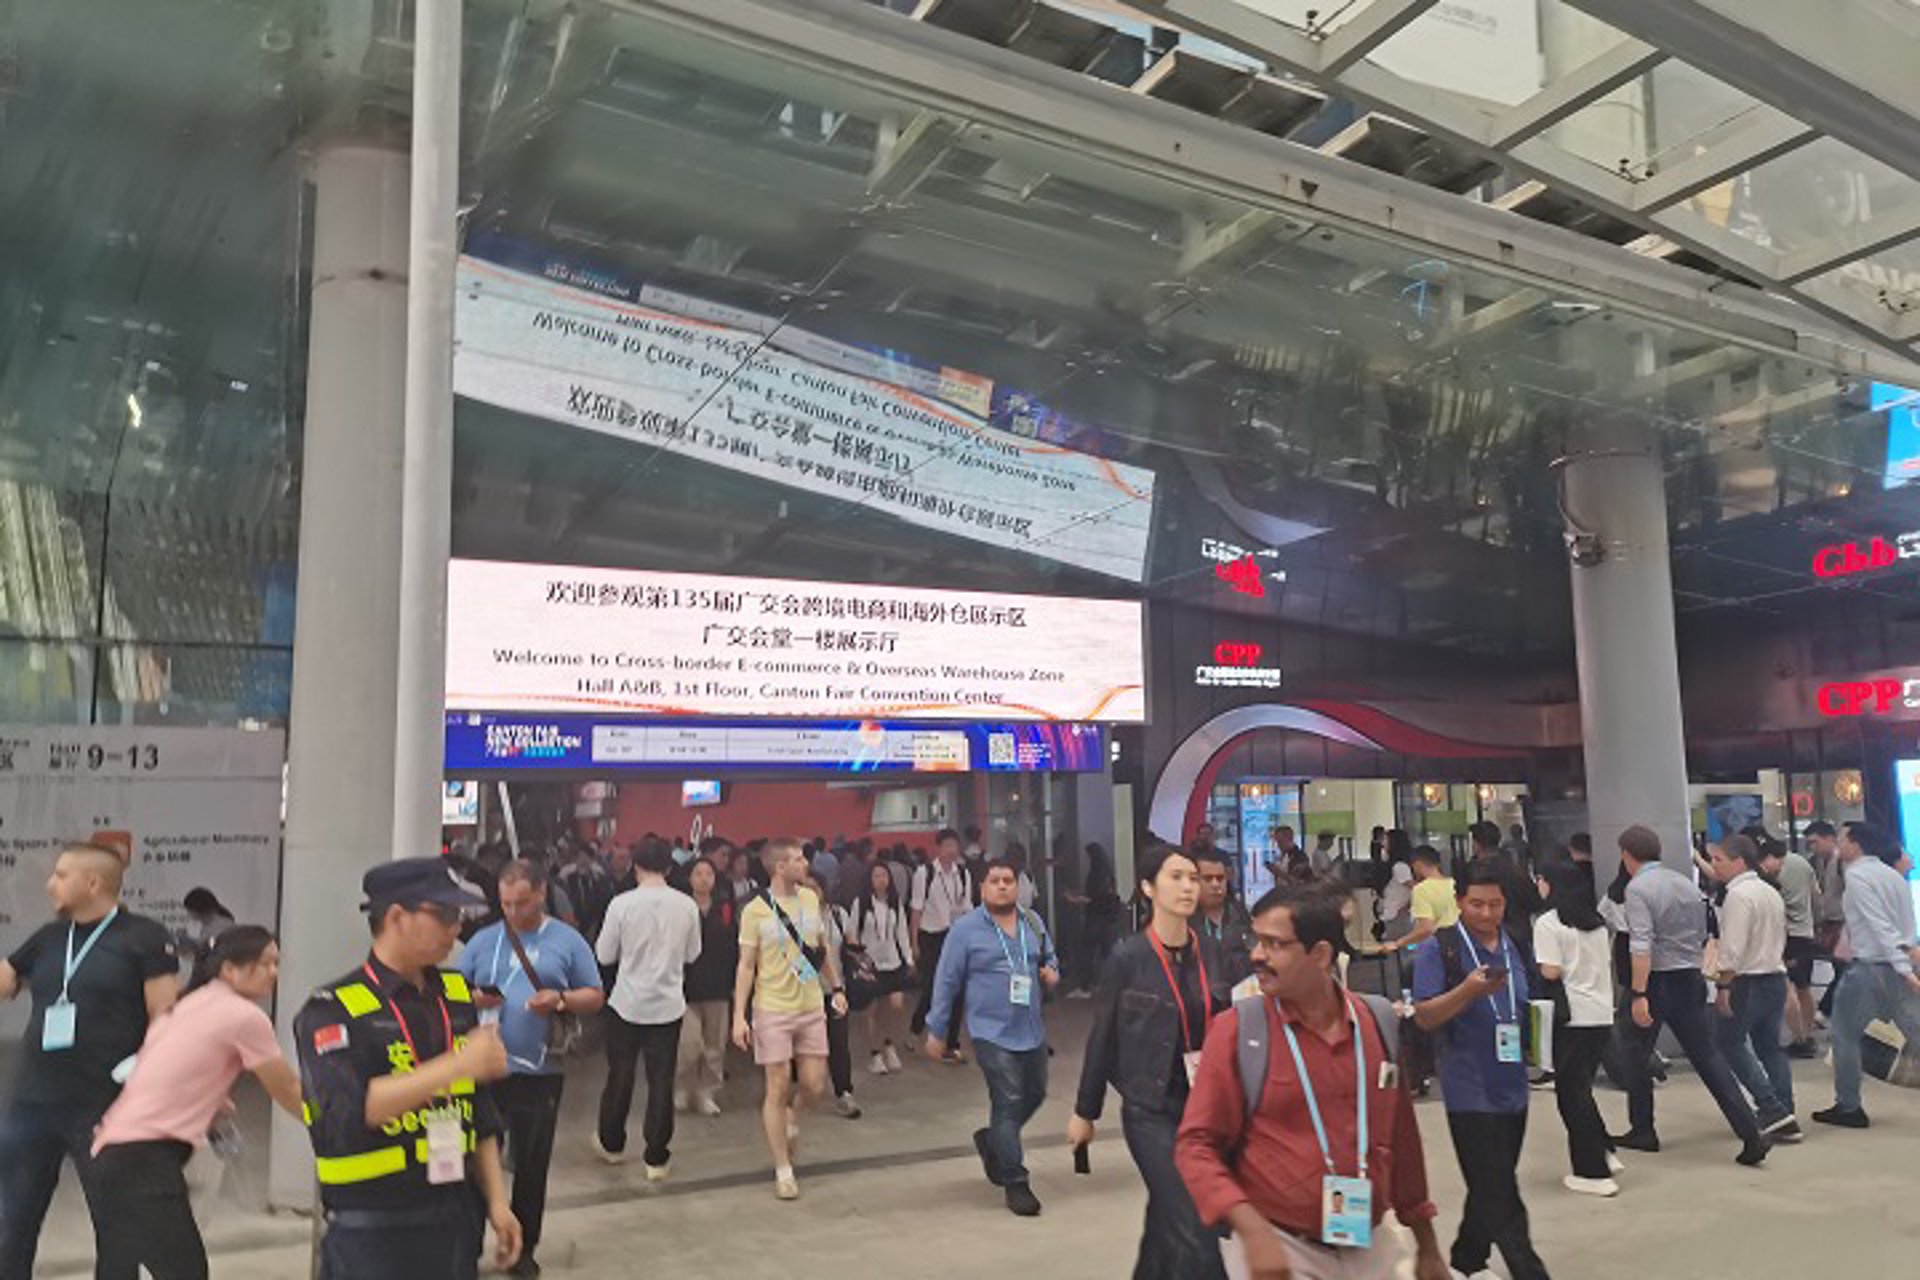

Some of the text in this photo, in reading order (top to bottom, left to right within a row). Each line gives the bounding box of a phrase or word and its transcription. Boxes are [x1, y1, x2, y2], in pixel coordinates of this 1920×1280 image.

[703, 623, 898, 653] 广交会堂一楼展示厅
[493, 649, 1065, 683] Welcome to Cross-border E-commerce & Overseas Warehouse Zone
[577, 678, 615, 693] Hall
[674, 681, 699, 696] 1st
[706, 682, 752, 699] Floor,
[759, 685, 819, 699] Canton
[826, 686, 855, 701] Fair
[860, 687, 951, 702] Convention
[954, 690, 1004, 704] Center
[1818, 677, 1900, 716] CPP
